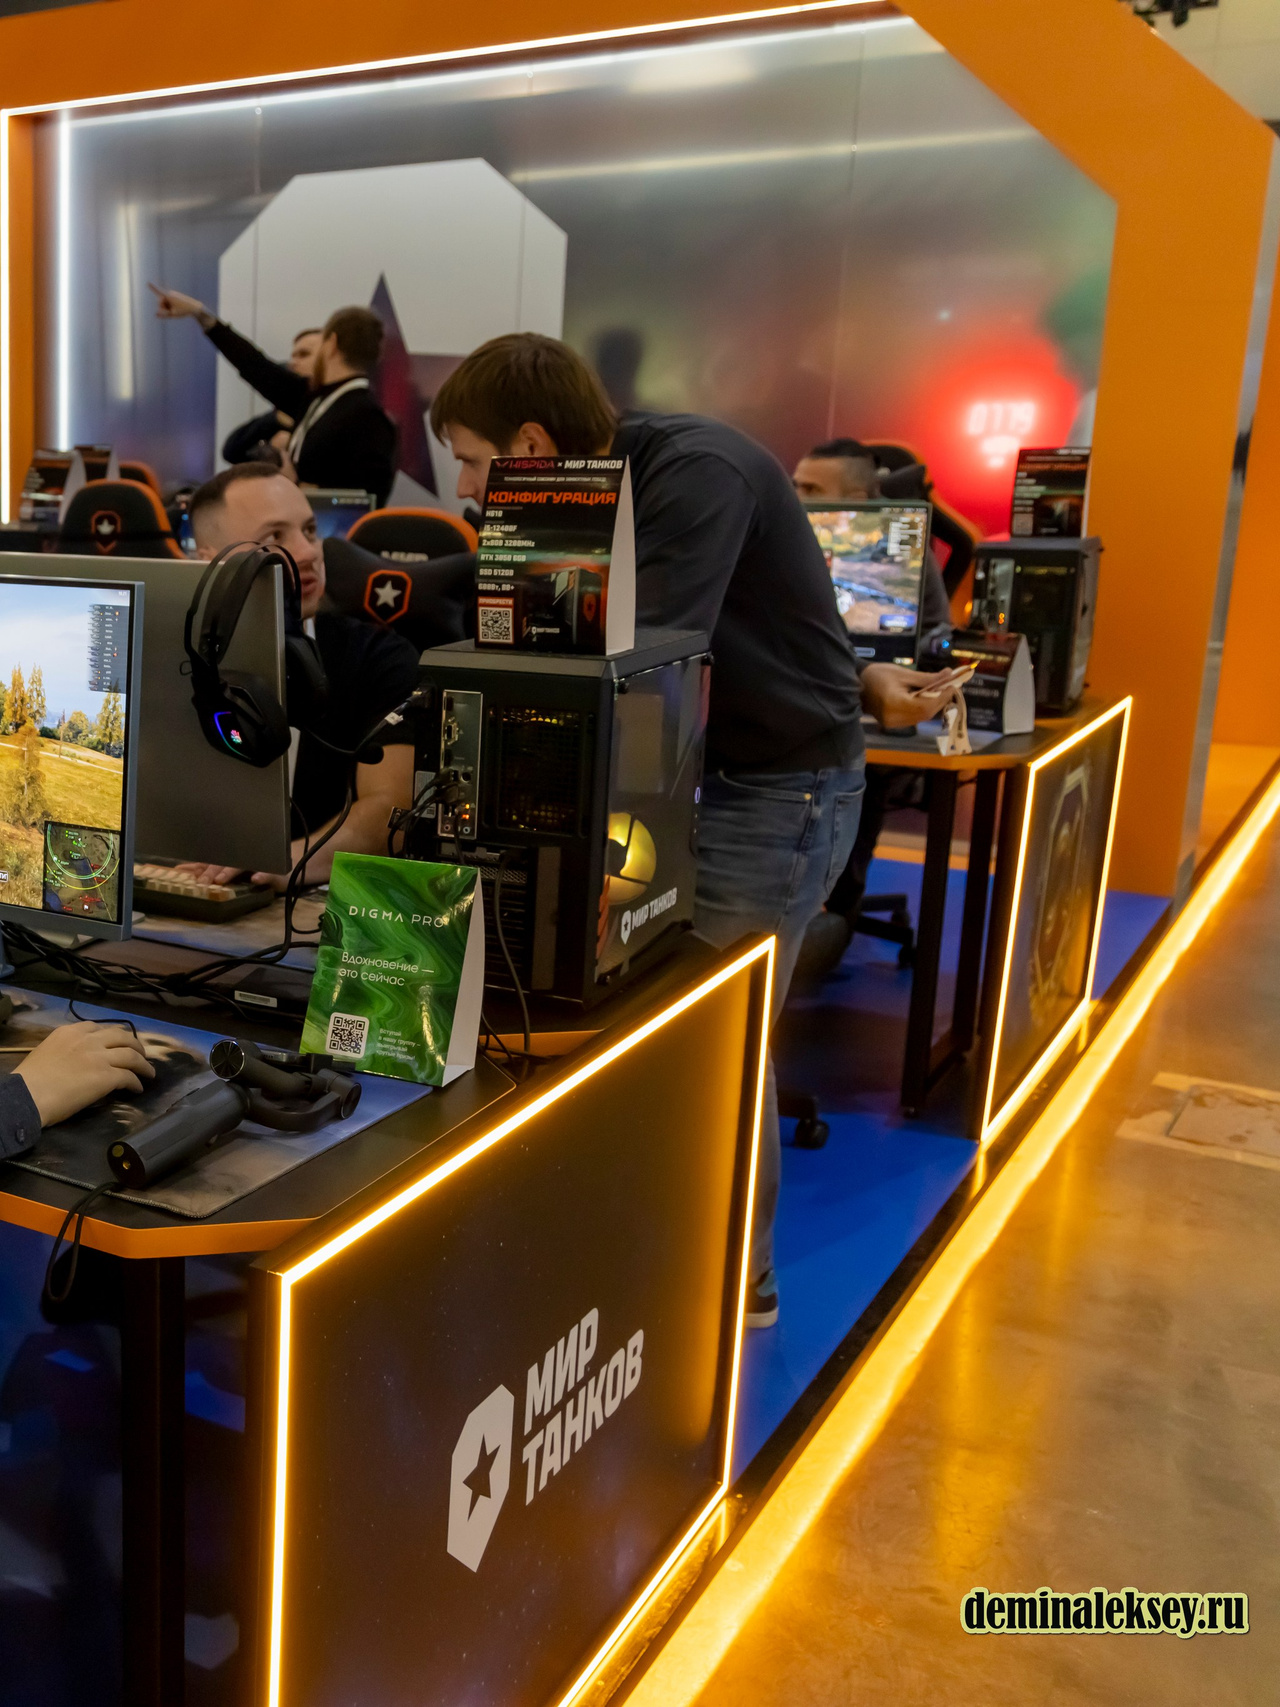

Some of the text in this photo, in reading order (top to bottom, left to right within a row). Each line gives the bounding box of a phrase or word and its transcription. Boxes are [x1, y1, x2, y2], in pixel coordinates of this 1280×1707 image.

[564, 460, 585, 469] МИР
[586, 460, 623, 469] ТАНКОВ
[488, 491, 617, 506] КОНФИГУРАЦИЯ
[349, 905, 444, 928] DIGMA PRO
[632, 887, 678, 930] МИР ТАНКОВ
[341, 951, 419, 973] Вдохновение
[339, 968, 406, 987] это сейчас
[523, 1306, 600, 1436] МИР
[521, 1328, 645, 1507] ТАНКОВ
